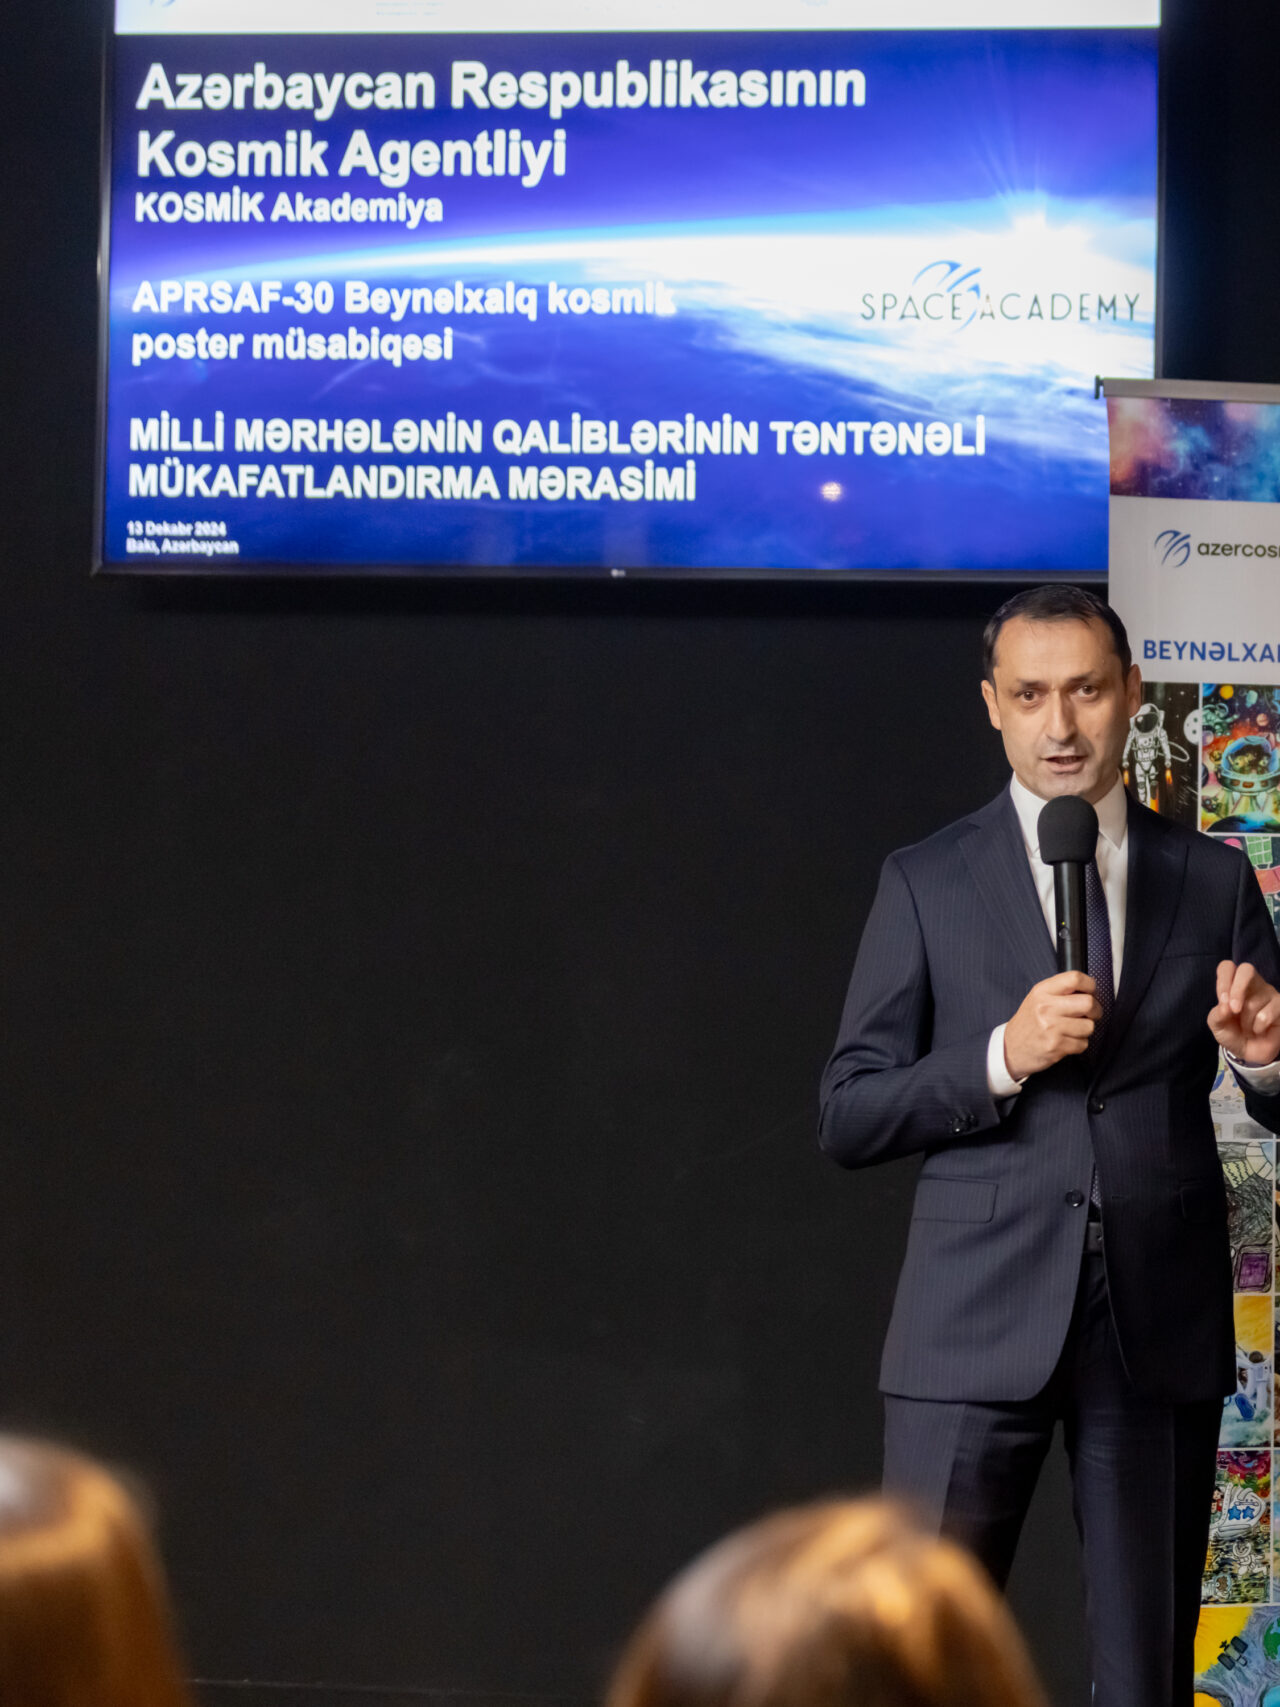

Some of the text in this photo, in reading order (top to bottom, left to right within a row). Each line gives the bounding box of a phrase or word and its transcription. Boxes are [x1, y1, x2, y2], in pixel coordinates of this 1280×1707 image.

[135, 60, 866, 121] Azərbaycan Respublikasının
[137, 129, 566, 188] Kosmik Agentliyi
[135, 186, 443, 229] KOSMİK Akademiya
[132, 280, 677, 321] APRSAF-30 Beynəlxalq kosmik
[860, 293, 1140, 322] SPACE ACADEMY
[132, 327, 453, 367] poster müsabiqəsi
[130, 411, 985, 456] MİLLİ MƏRHƏLƏNİN QALİBLƏRİNİN TƏNTƏNƏLİ
[129, 458, 696, 500] MÜKAFATLANDIRMA MƏRASİMİ
[127, 520, 143, 536] 13
